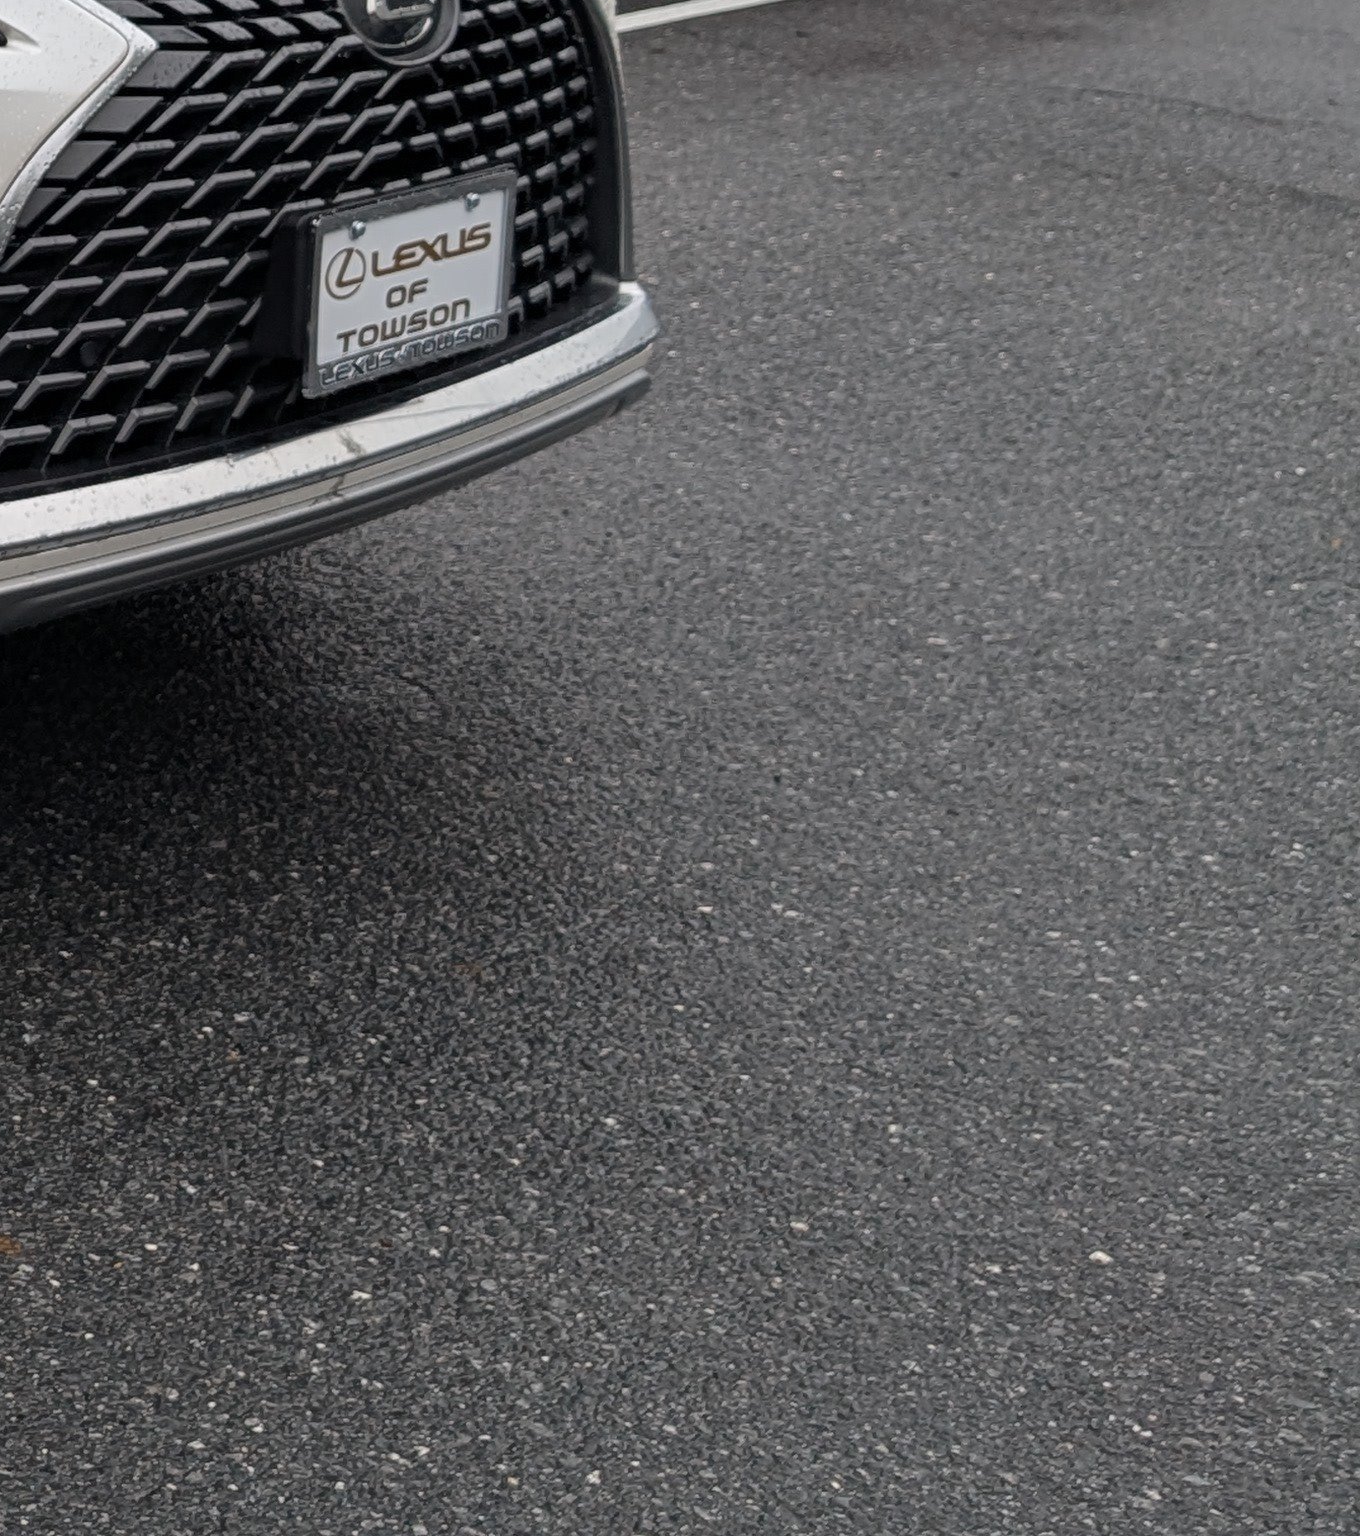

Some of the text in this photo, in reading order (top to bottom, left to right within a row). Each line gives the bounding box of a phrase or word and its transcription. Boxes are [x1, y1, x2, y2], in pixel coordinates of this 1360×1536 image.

[372, 222, 492, 277] LEXUS
[385, 277, 429, 308] OF
[336, 298, 471, 354] TOWSON
[319, 347, 396, 389] LEXUS
